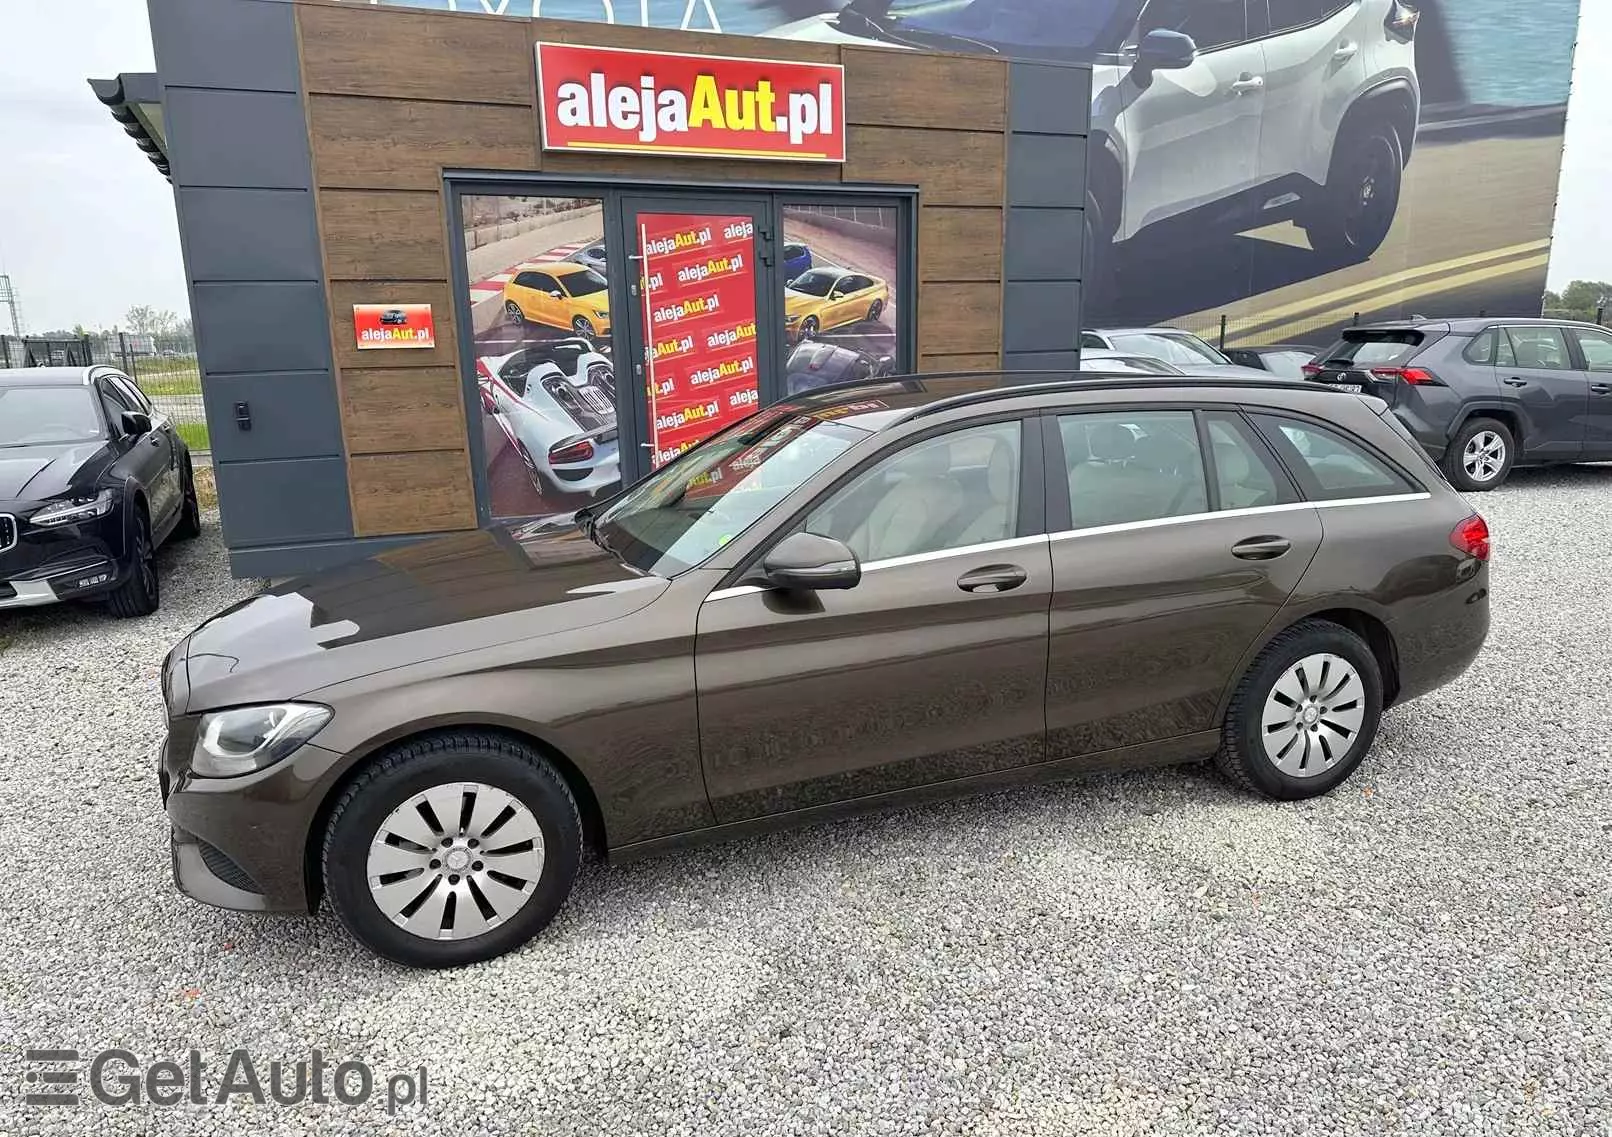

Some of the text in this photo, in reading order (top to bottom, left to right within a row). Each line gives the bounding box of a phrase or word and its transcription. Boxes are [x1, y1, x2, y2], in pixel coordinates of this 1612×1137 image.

[557, 72, 832, 144] alejaAut.pl
[646, 222, 753, 255] alejaAut.pl aleja
[677, 254, 743, 281] alejaAut.pl
[653, 294, 720, 322] alejaAut.pl
[361, 327, 430, 342] alejaAut.pl
[706, 323, 757, 347] alejaAut
[690, 356, 754, 385] alejaAut.pl
[656, 388, 758, 430] alejaAut.pl aleja
